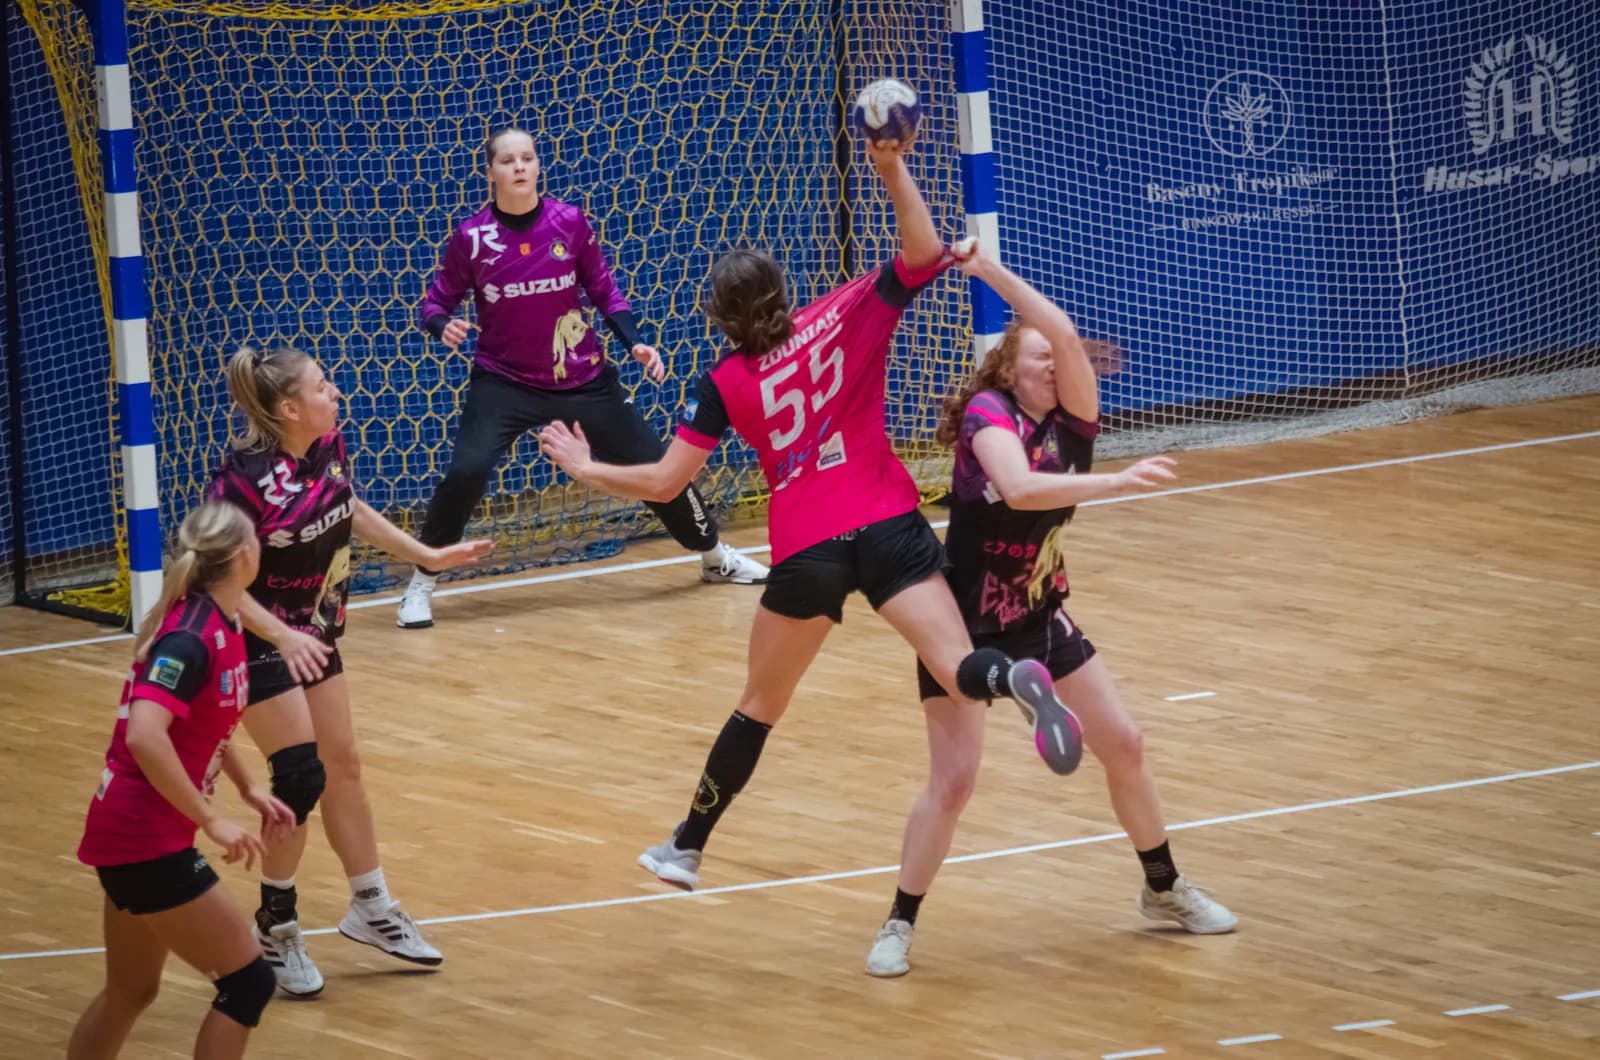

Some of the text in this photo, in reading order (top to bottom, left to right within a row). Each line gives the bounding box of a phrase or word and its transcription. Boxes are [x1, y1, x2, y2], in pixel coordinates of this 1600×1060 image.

[1147, 182, 1222, 204] Baseny
[760, 323, 845, 450] 55
[257, 460, 303, 505] 22
